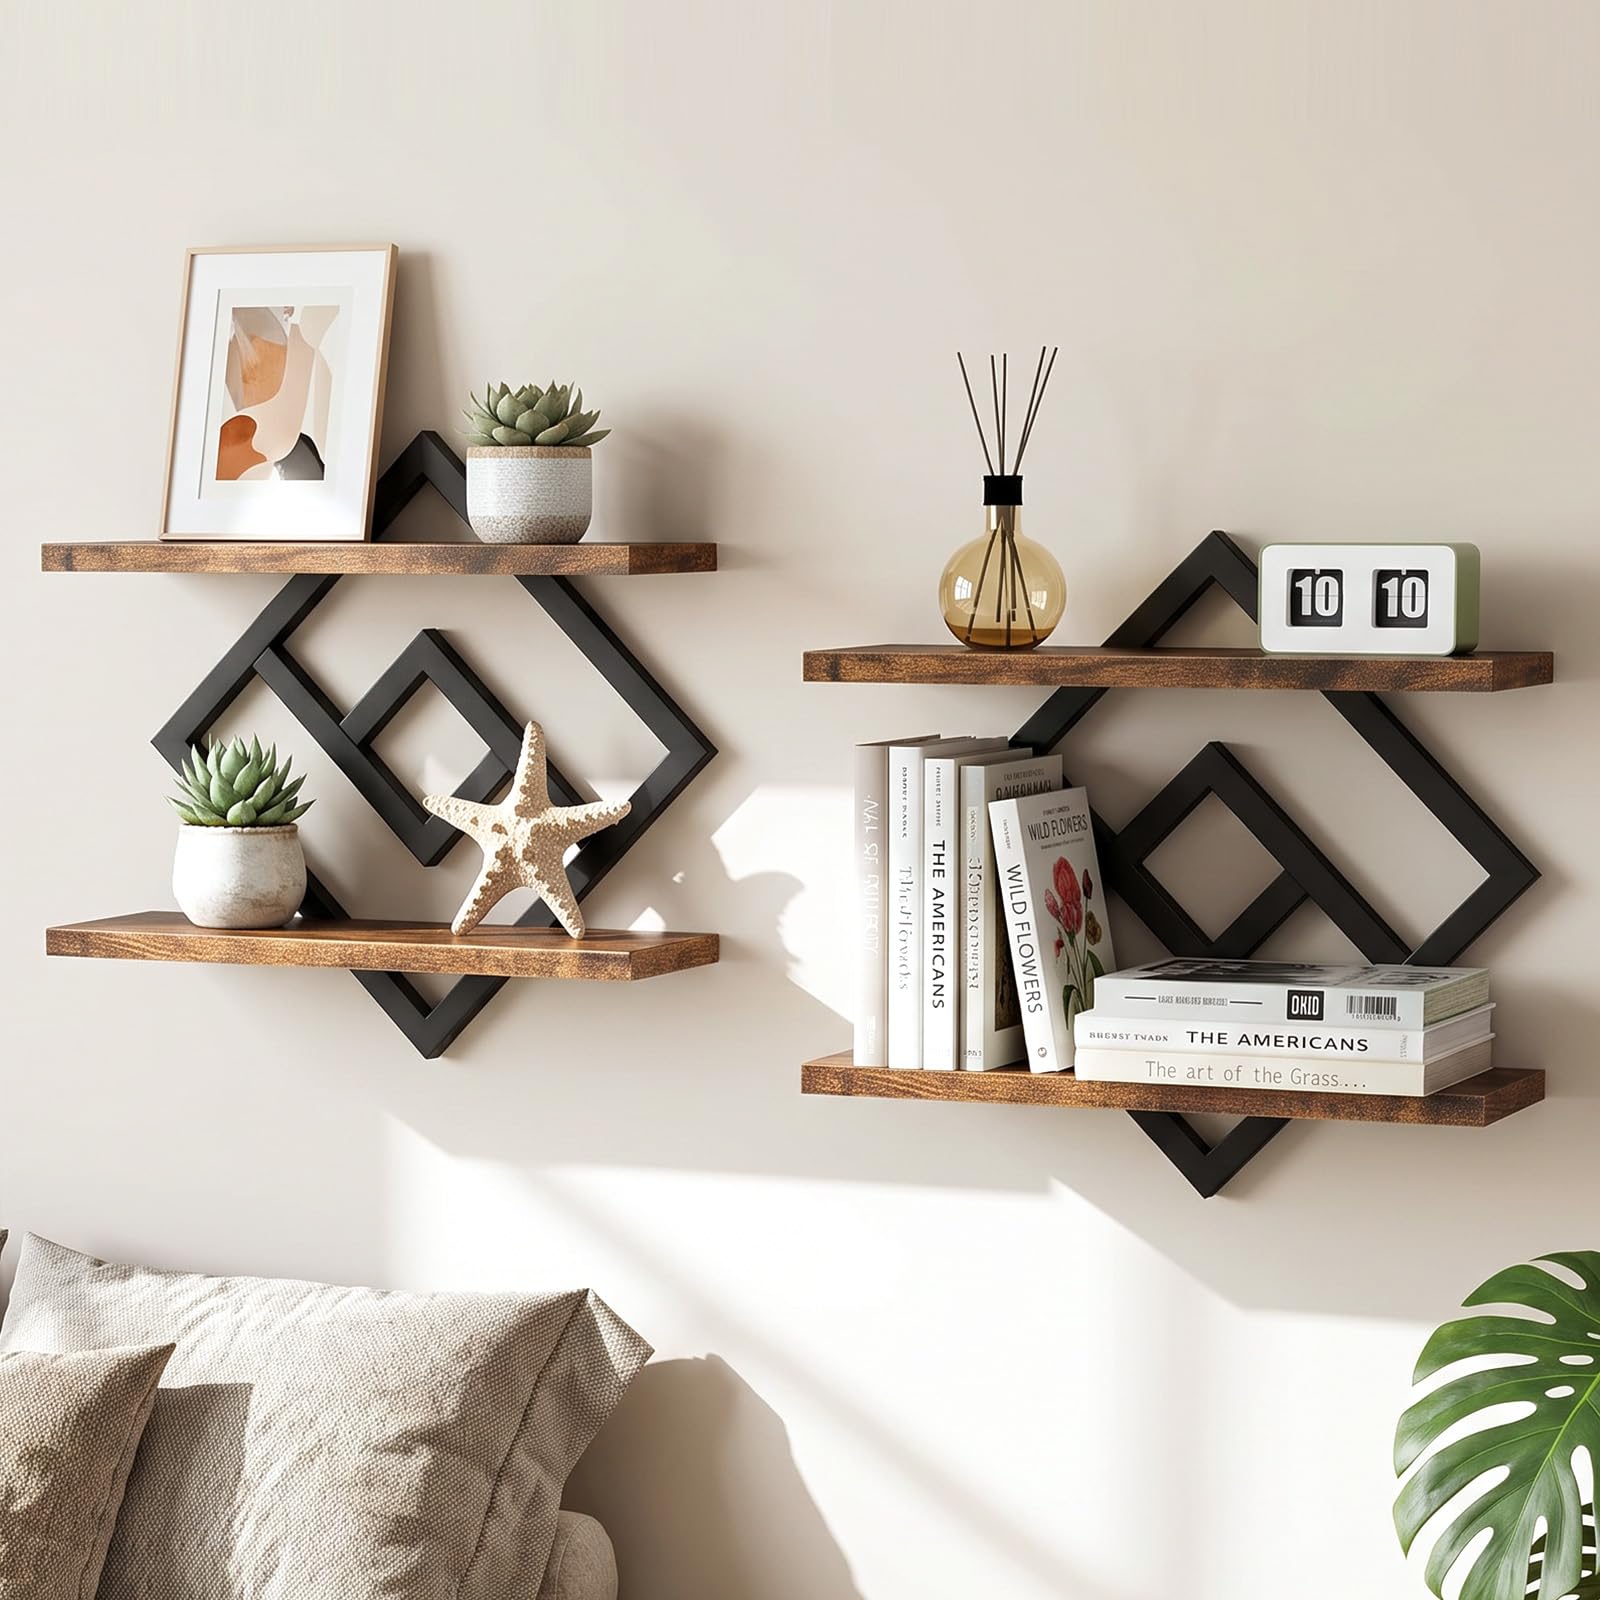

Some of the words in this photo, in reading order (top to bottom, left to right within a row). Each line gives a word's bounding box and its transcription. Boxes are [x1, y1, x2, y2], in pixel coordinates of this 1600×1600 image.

[1296, 576, 1338, 617] 10
[1382, 577, 1426, 618] 10
[1028, 821, 1050, 840] WILD
[1052, 814, 1088, 838] FLOWERS
[932, 840, 945, 878] THE
[1007, 864, 1027, 915] WILD
[932, 888, 945, 1009] AMERICANS
[1015, 921, 1043, 1013] FLOWERS
[1186, 1031, 1228, 1045] THE
[1237, 1033, 1369, 1052] AMERICANS
[1145, 1061, 1177, 1079] The
[1186, 1064, 1214, 1081] art
[1223, 1065, 1243, 1082] of
[1254, 1066, 1283, 1084] the
